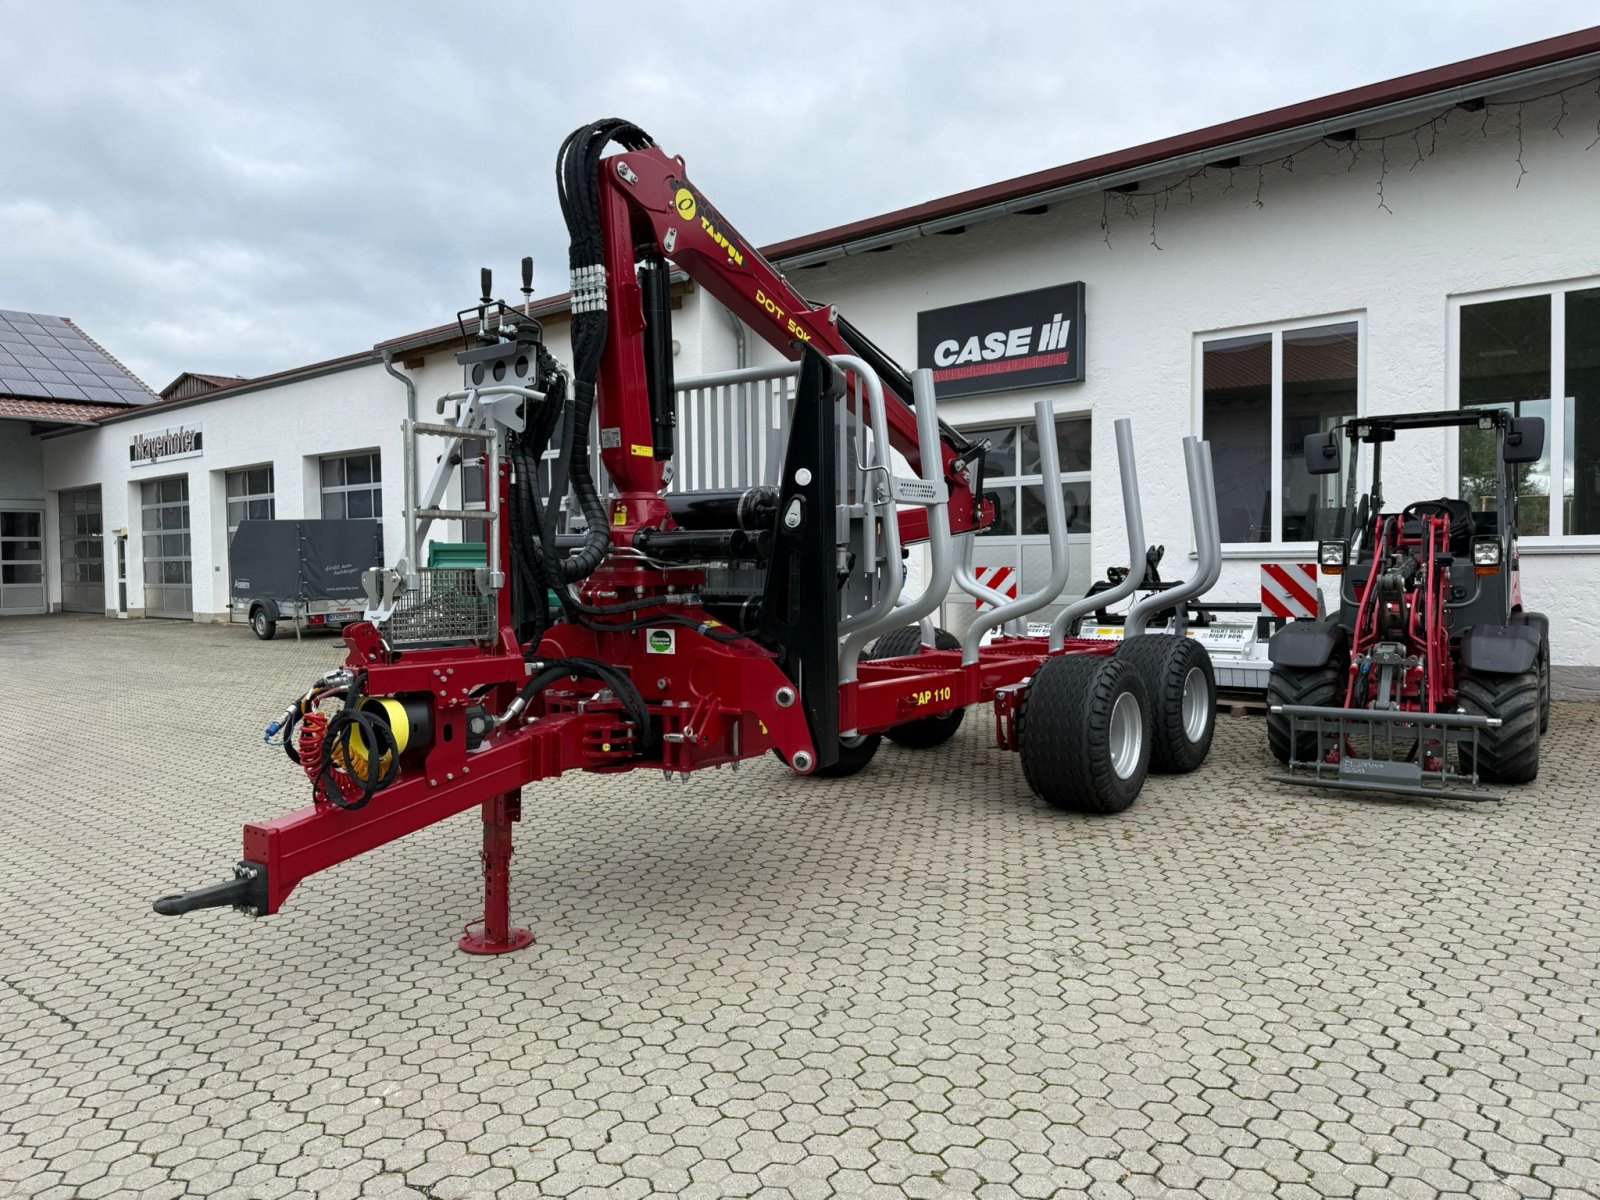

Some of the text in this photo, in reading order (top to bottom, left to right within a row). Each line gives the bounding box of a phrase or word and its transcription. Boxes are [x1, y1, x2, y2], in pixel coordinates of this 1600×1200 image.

[701, 215, 743, 266] TAJFUN
[756, 289, 811, 342] DOT 50K
[933, 326, 1033, 368] CASE
[133, 425, 196, 463] Mayerhofer
[934, 686, 951, 702] 110
